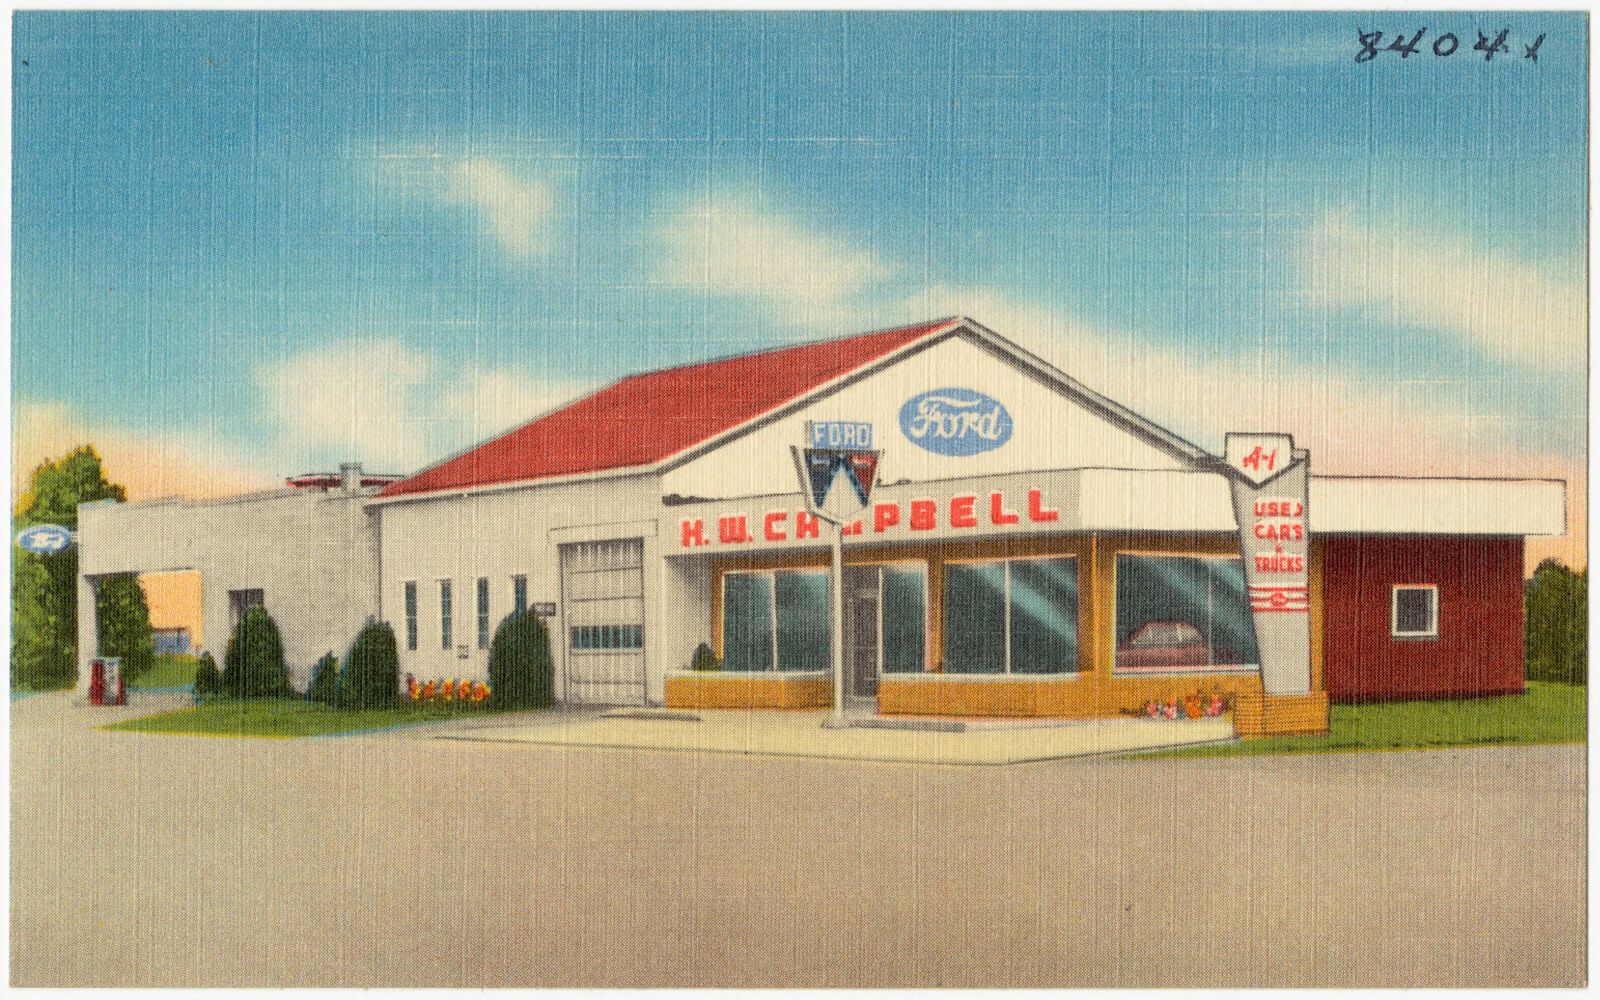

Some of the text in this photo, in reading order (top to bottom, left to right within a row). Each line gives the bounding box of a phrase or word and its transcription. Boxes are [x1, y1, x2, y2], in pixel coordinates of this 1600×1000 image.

[910, 396, 1002, 440] Ford
[813, 422, 870, 446] FORD
[1254, 524, 1303, 540] CARS
[1254, 556, 1303, 573] TRUCKS
